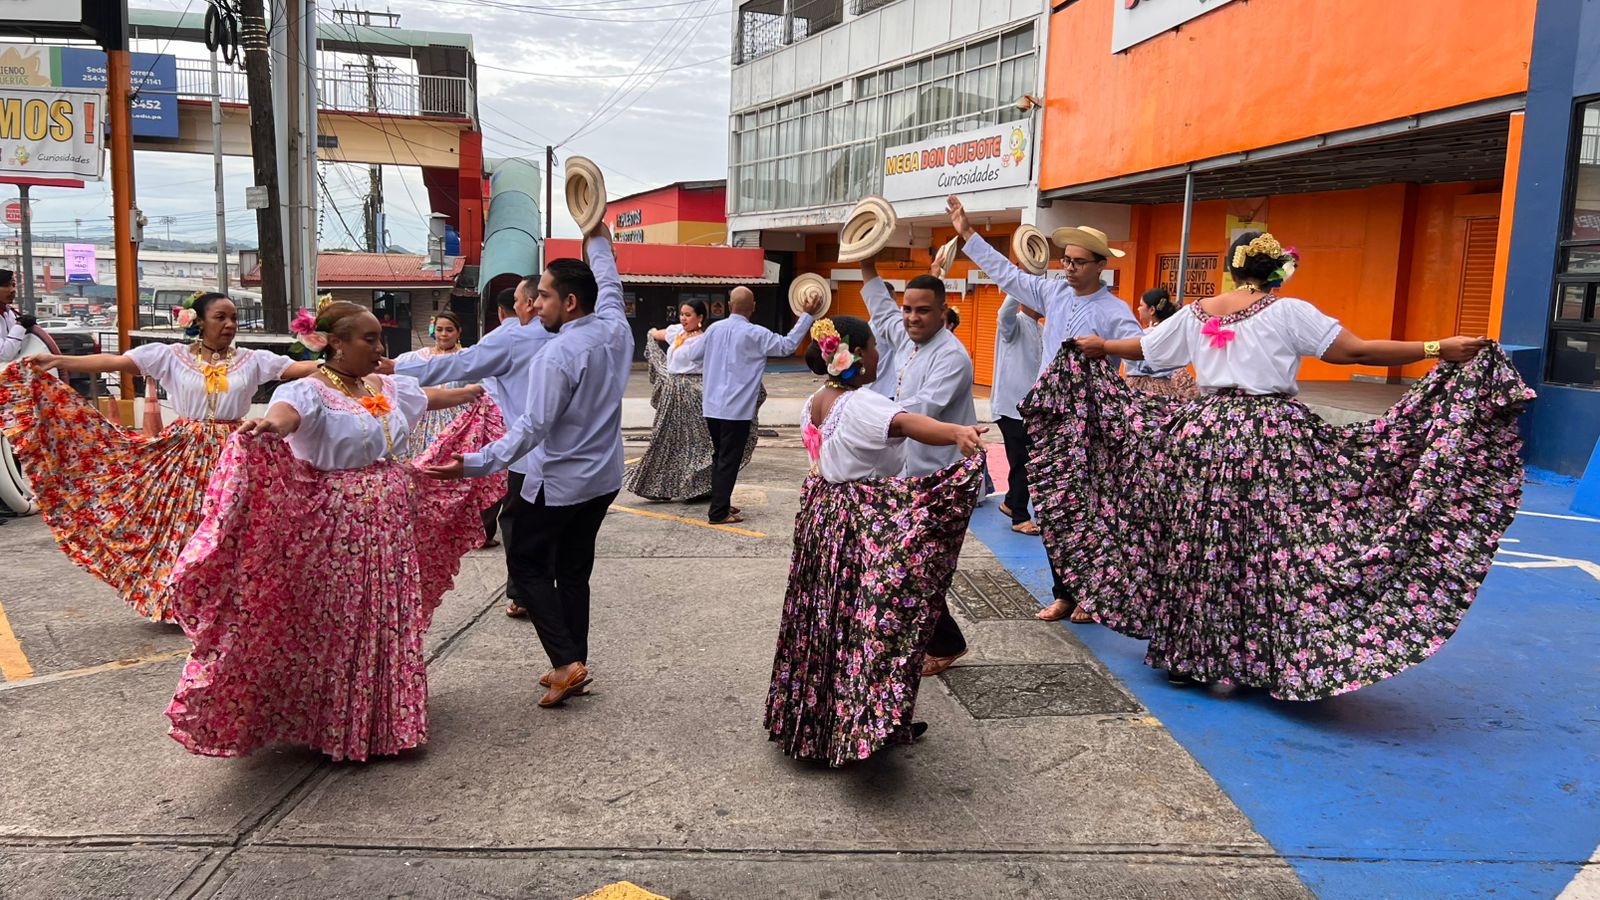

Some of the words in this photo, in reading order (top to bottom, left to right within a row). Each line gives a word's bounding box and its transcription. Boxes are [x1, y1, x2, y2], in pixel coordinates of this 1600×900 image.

[86, 66, 107, 74] Sede
[37, 153, 91, 164] Curiosidades
[886, 151, 920, 176] MEGA
[921, 146, 946, 170] DON
[947, 135, 1001, 167] QUIJOTE
[937, 163, 1000, 187] Curiosidades
[1162, 257, 1218, 270] ESTANAMIENTO
[1169, 270, 1207, 282] EXUSIVO
[1184, 282, 1216, 295] LIENTES
